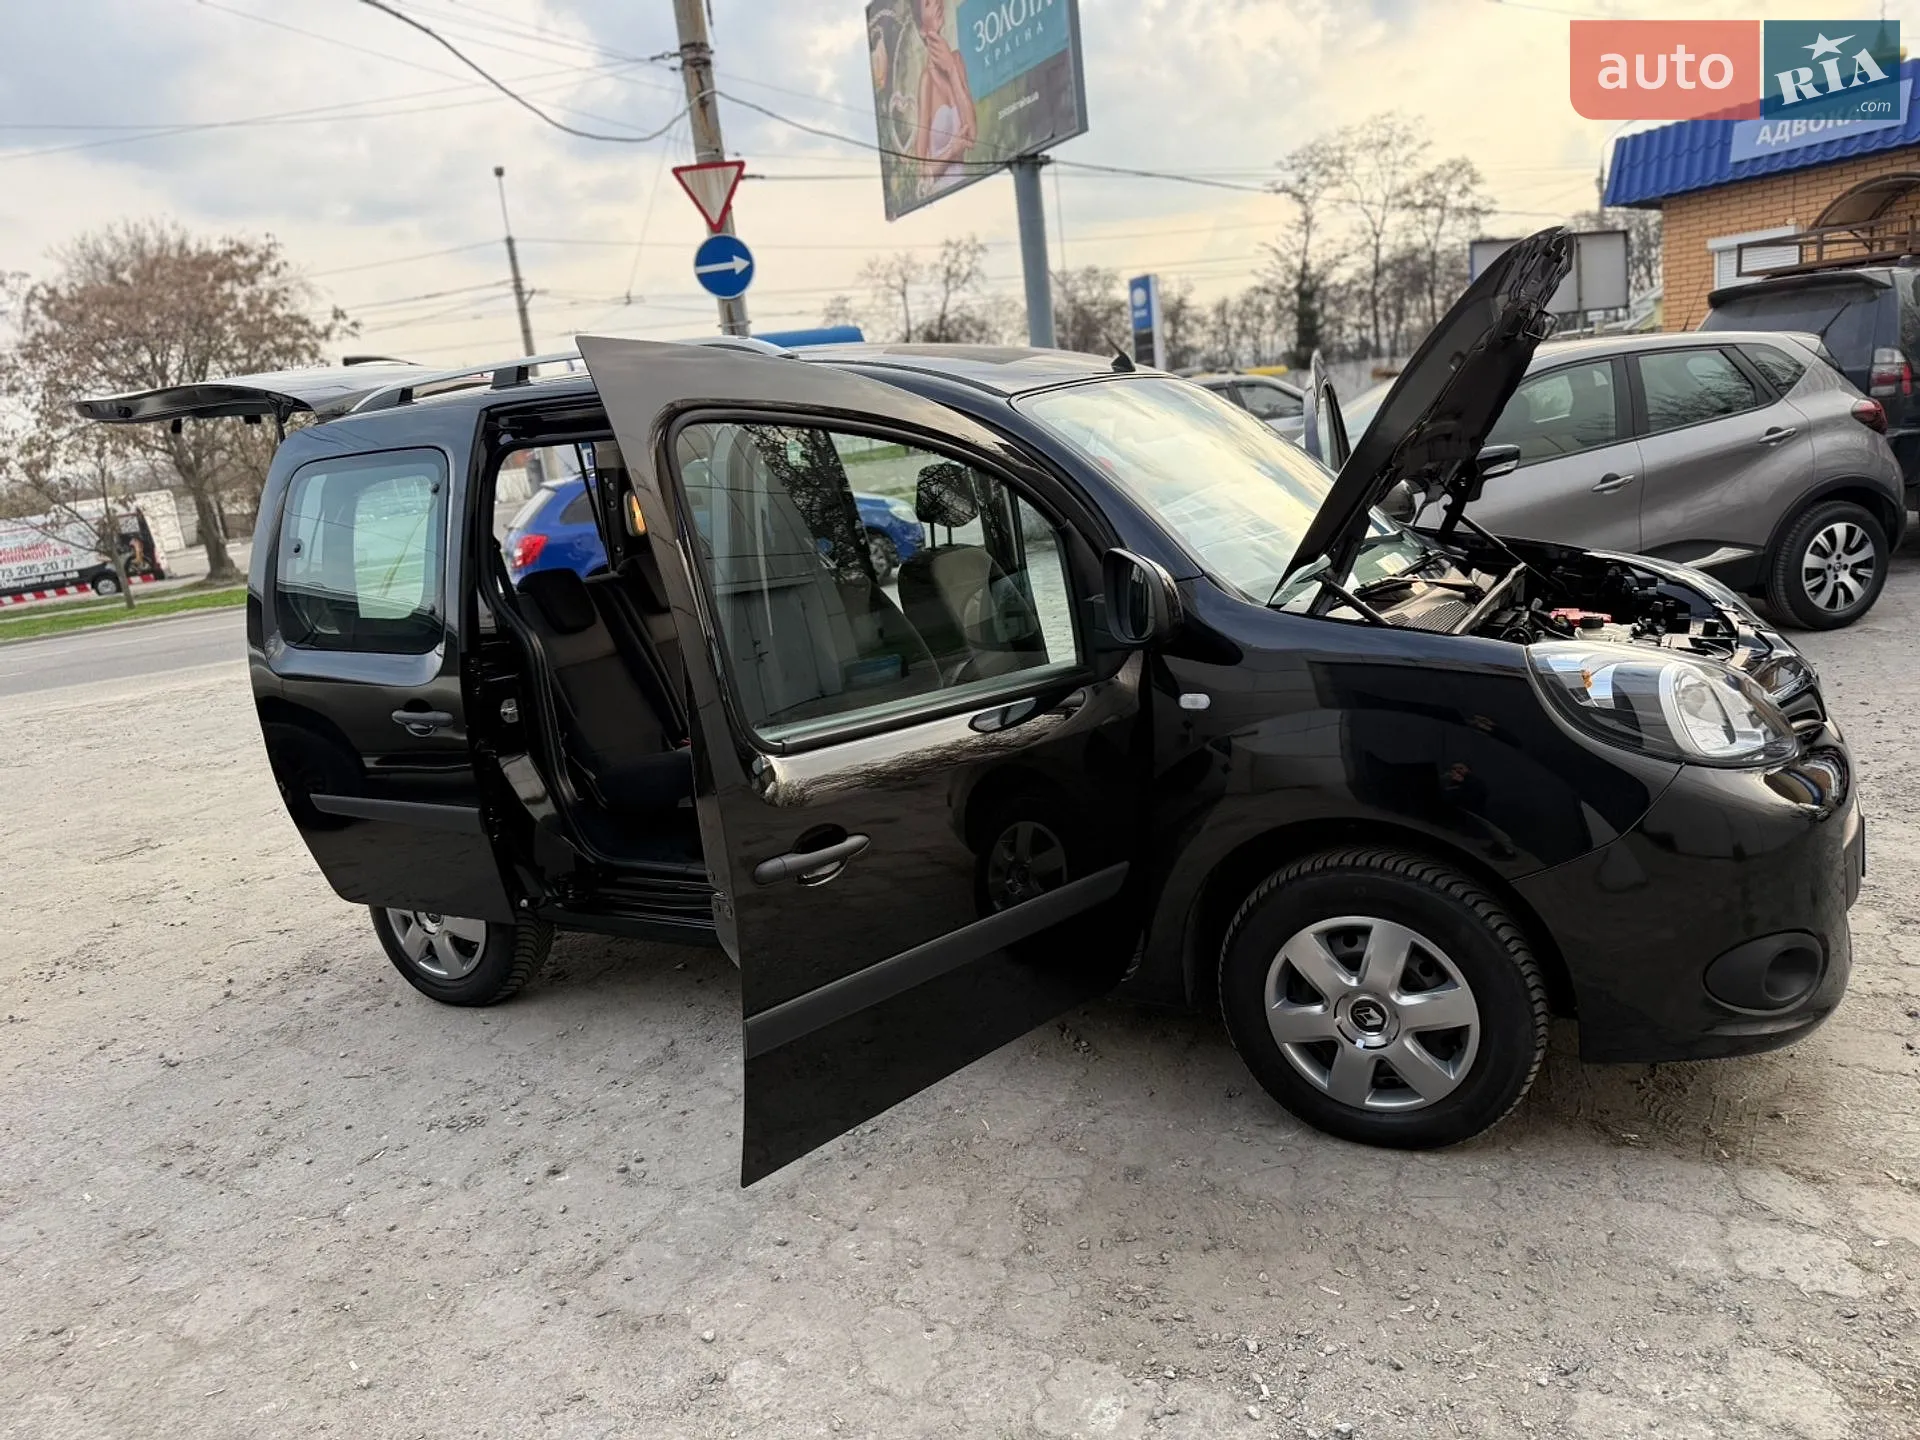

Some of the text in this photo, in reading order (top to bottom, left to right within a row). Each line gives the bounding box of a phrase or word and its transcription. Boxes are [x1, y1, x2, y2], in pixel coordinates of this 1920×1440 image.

[974, 0, 1052, 52] ЗОЛО
[16, 563, 40, 576] 205
[42, 560, 59, 571] 20
[62, 558, 74, 569] 77
